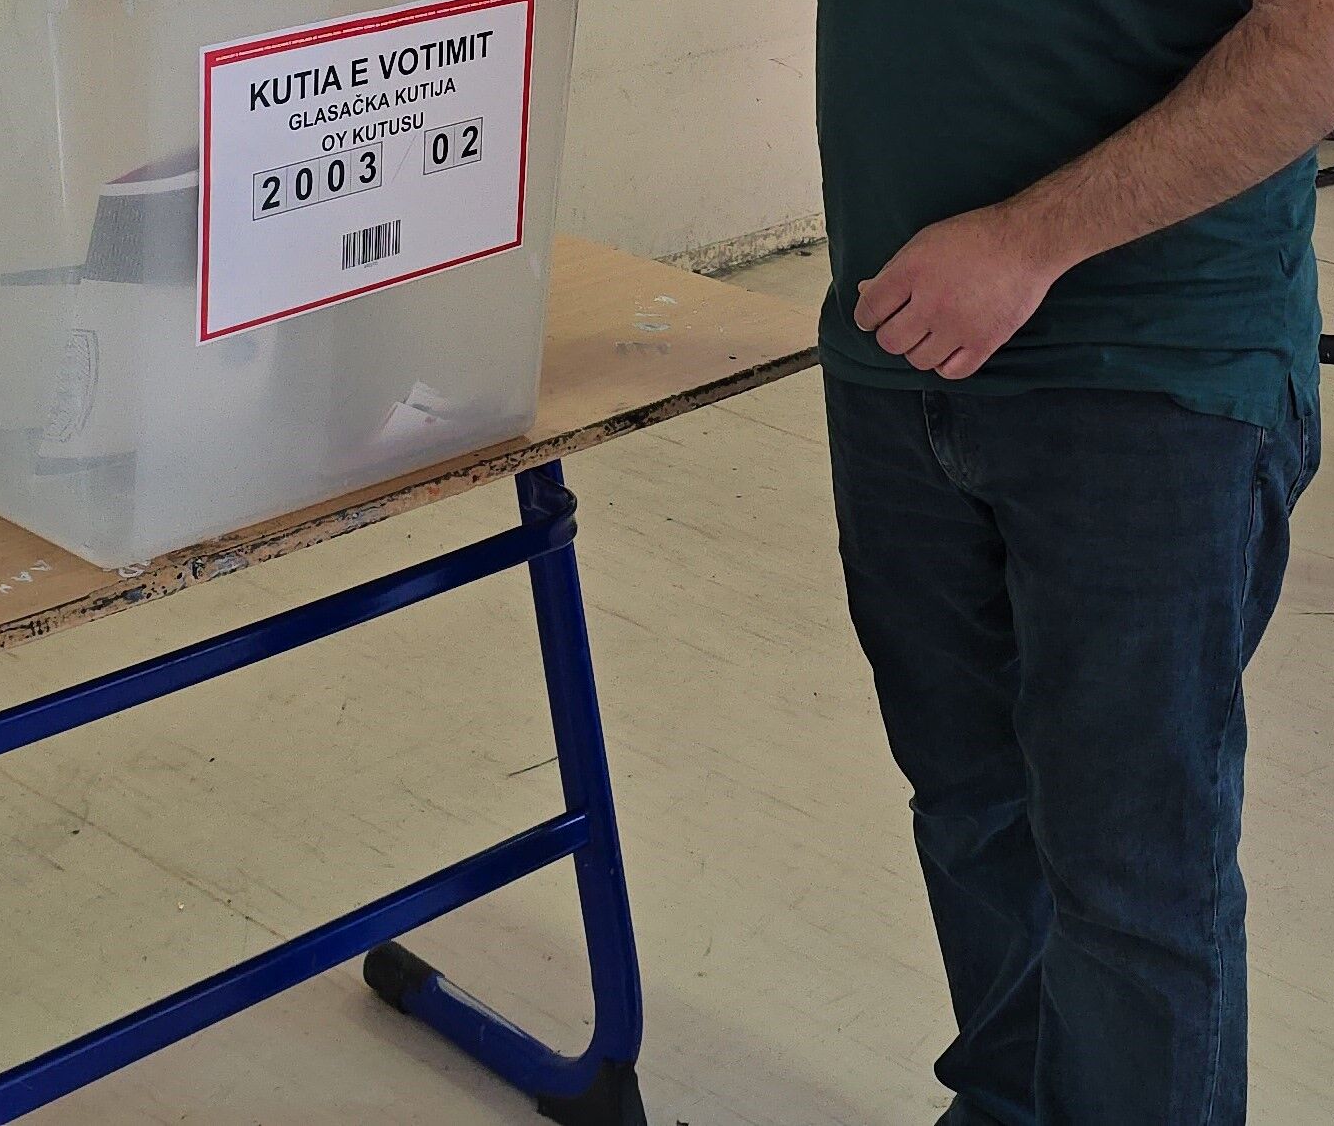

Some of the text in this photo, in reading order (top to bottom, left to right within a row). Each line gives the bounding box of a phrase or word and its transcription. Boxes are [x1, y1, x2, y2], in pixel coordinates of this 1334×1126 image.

[249, 30, 494, 112] KUTIA E VOTIMIT
[288, 77, 456, 131] GLASAČKA KUTIJA
[321, 111, 424, 152] OY KUTUSU
[261, 125, 479, 212] 2003 02
